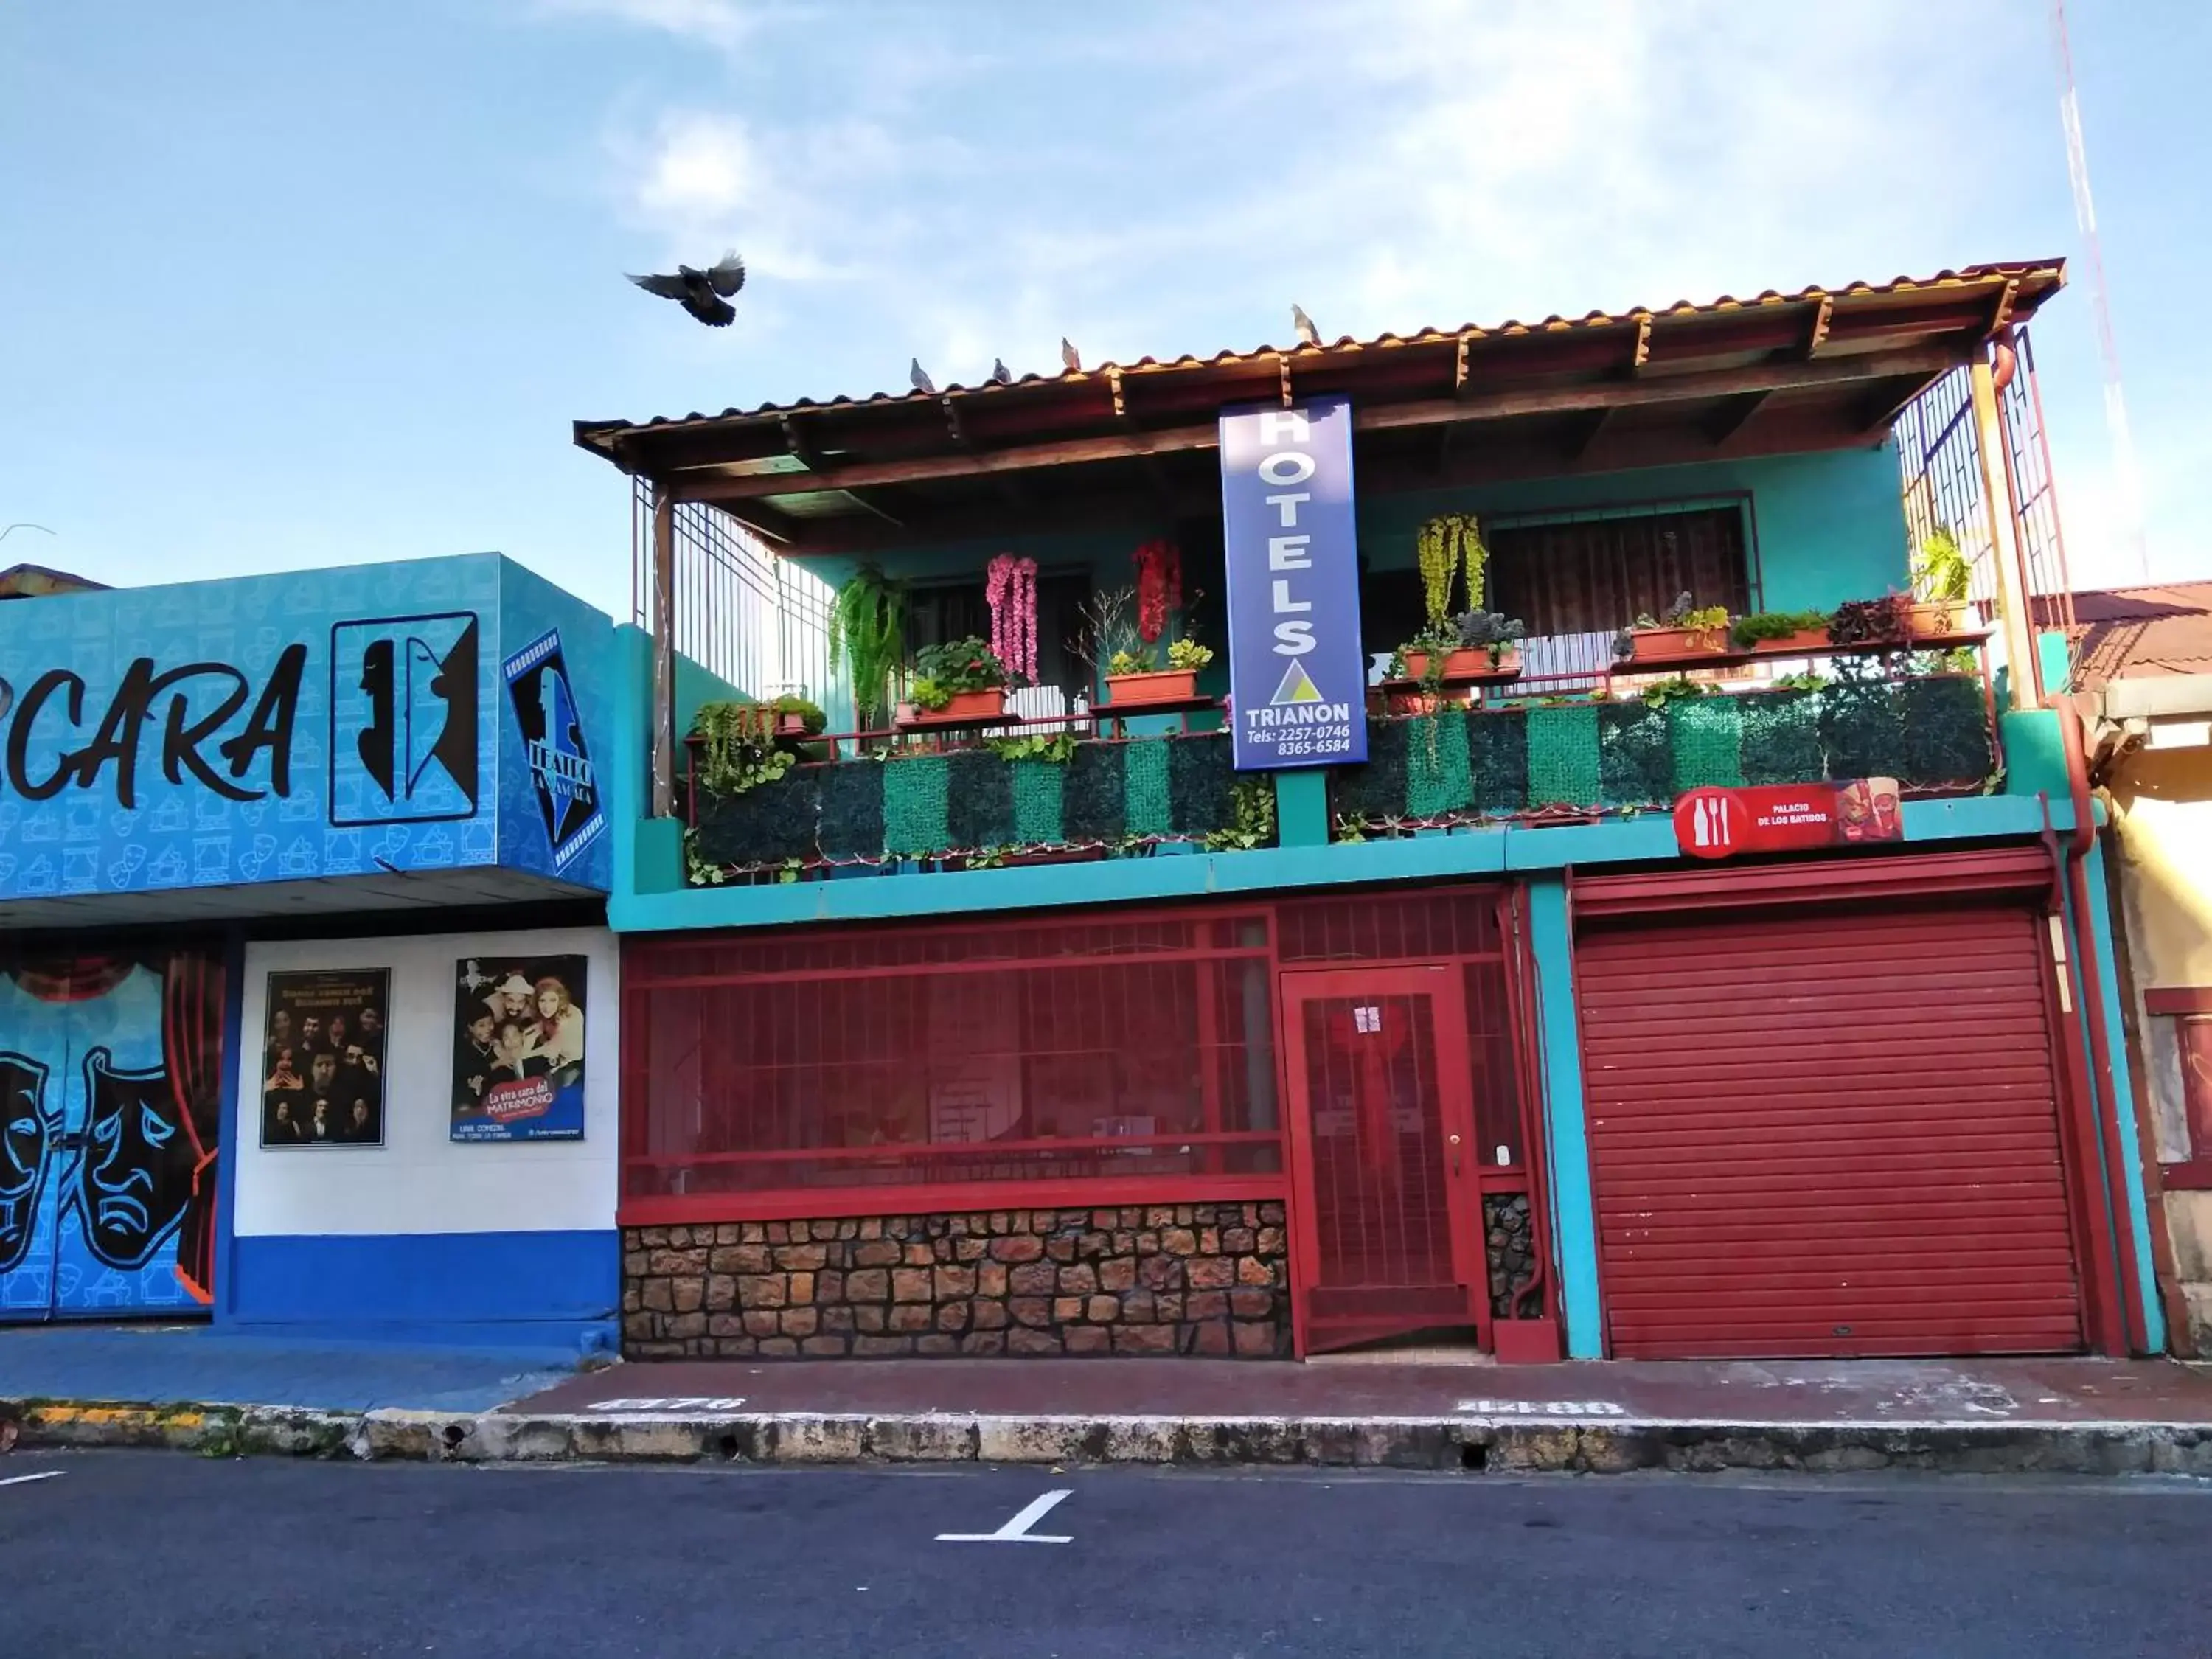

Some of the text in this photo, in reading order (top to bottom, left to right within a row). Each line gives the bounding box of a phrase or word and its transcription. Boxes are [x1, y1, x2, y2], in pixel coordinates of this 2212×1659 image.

[1258, 409, 1316, 655] HOTELS
[1245, 703, 1350, 728] TRIANON
[0, 644, 307, 809] CARA
[1248, 724, 1350, 743] Tels: 2257-0746
[1278, 739, 1350, 756] 8365-6584
[1773, 803, 1810, 813] PALACIO
[1758, 813, 1827, 827] DE LOS BATIDOS
[487, 1091, 554, 1115] MATRIMONIO
[489, 1093, 499, 1104] La
